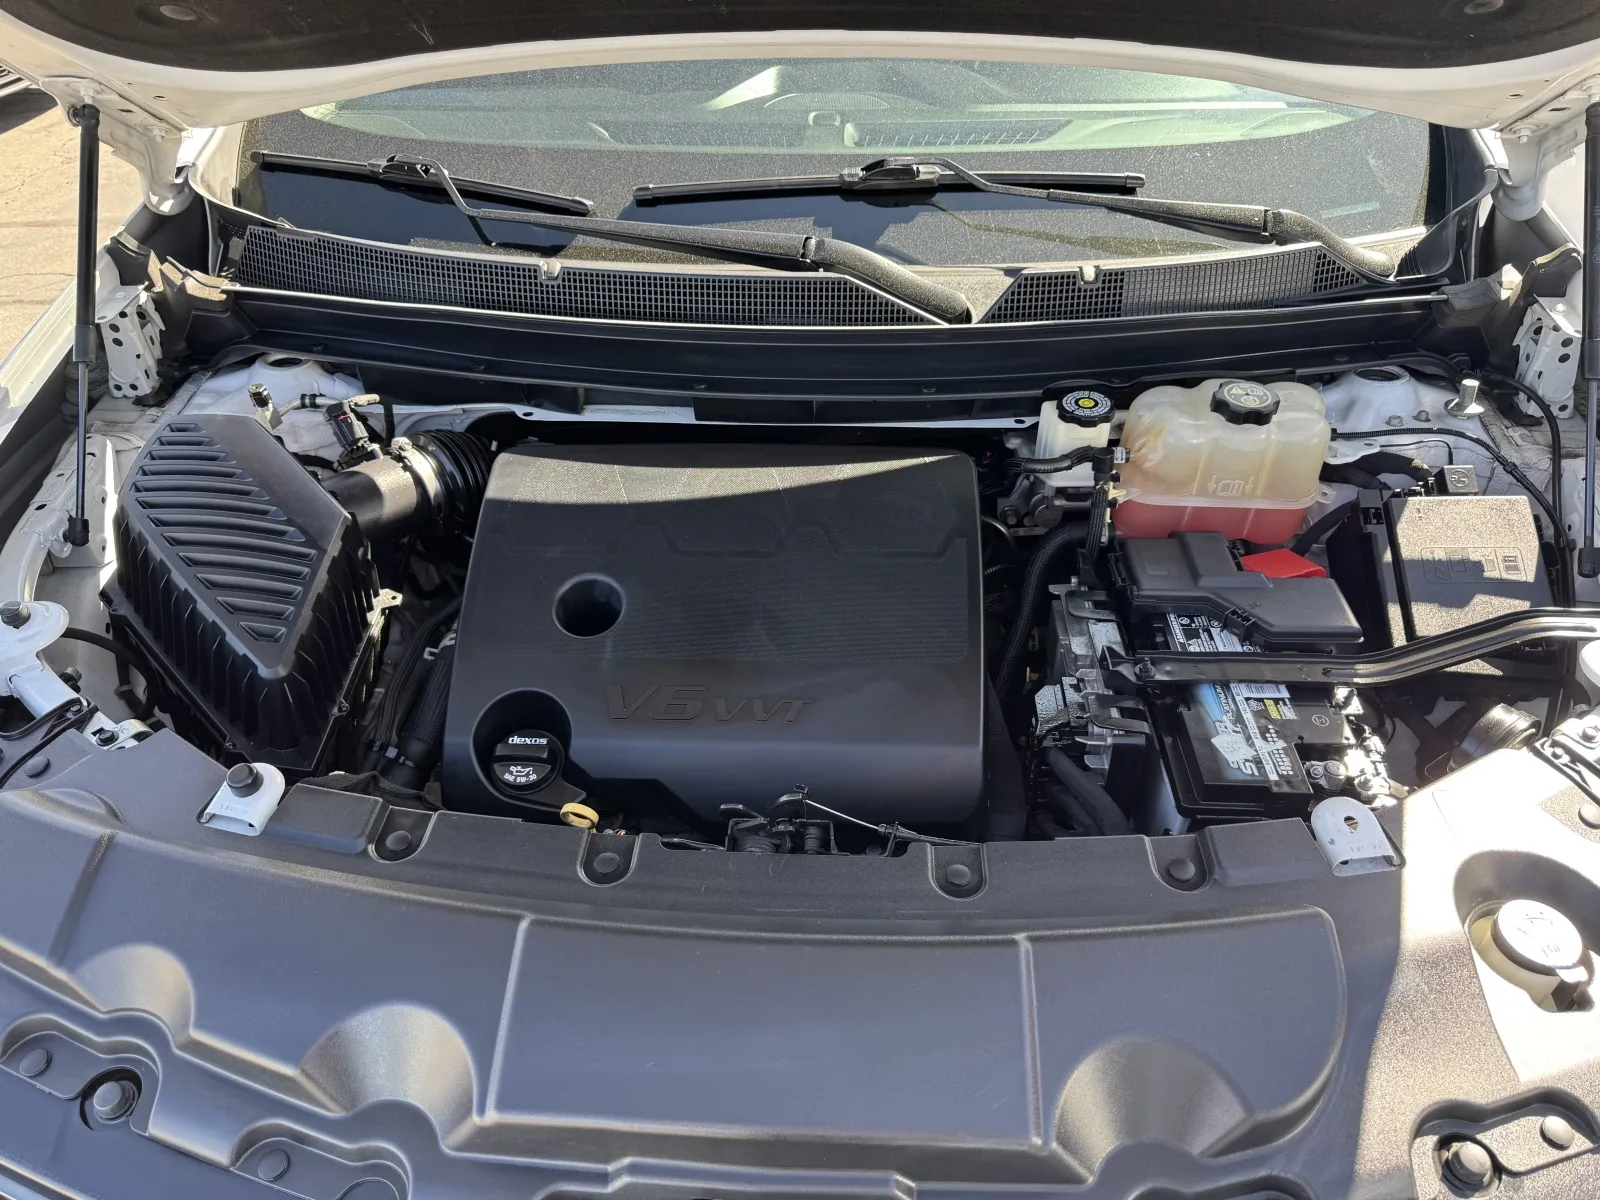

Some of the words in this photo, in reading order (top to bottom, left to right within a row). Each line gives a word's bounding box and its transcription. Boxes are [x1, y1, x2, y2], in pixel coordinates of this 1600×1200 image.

[605, 684, 709, 721] V6
[714, 697, 814, 723] VVT
[1214, 685, 1235, 720] PLATINUM
[508, 735, 549, 745] dexos
[503, 772, 515, 782] SAE
[516, 773, 537, 783] 5W-30
